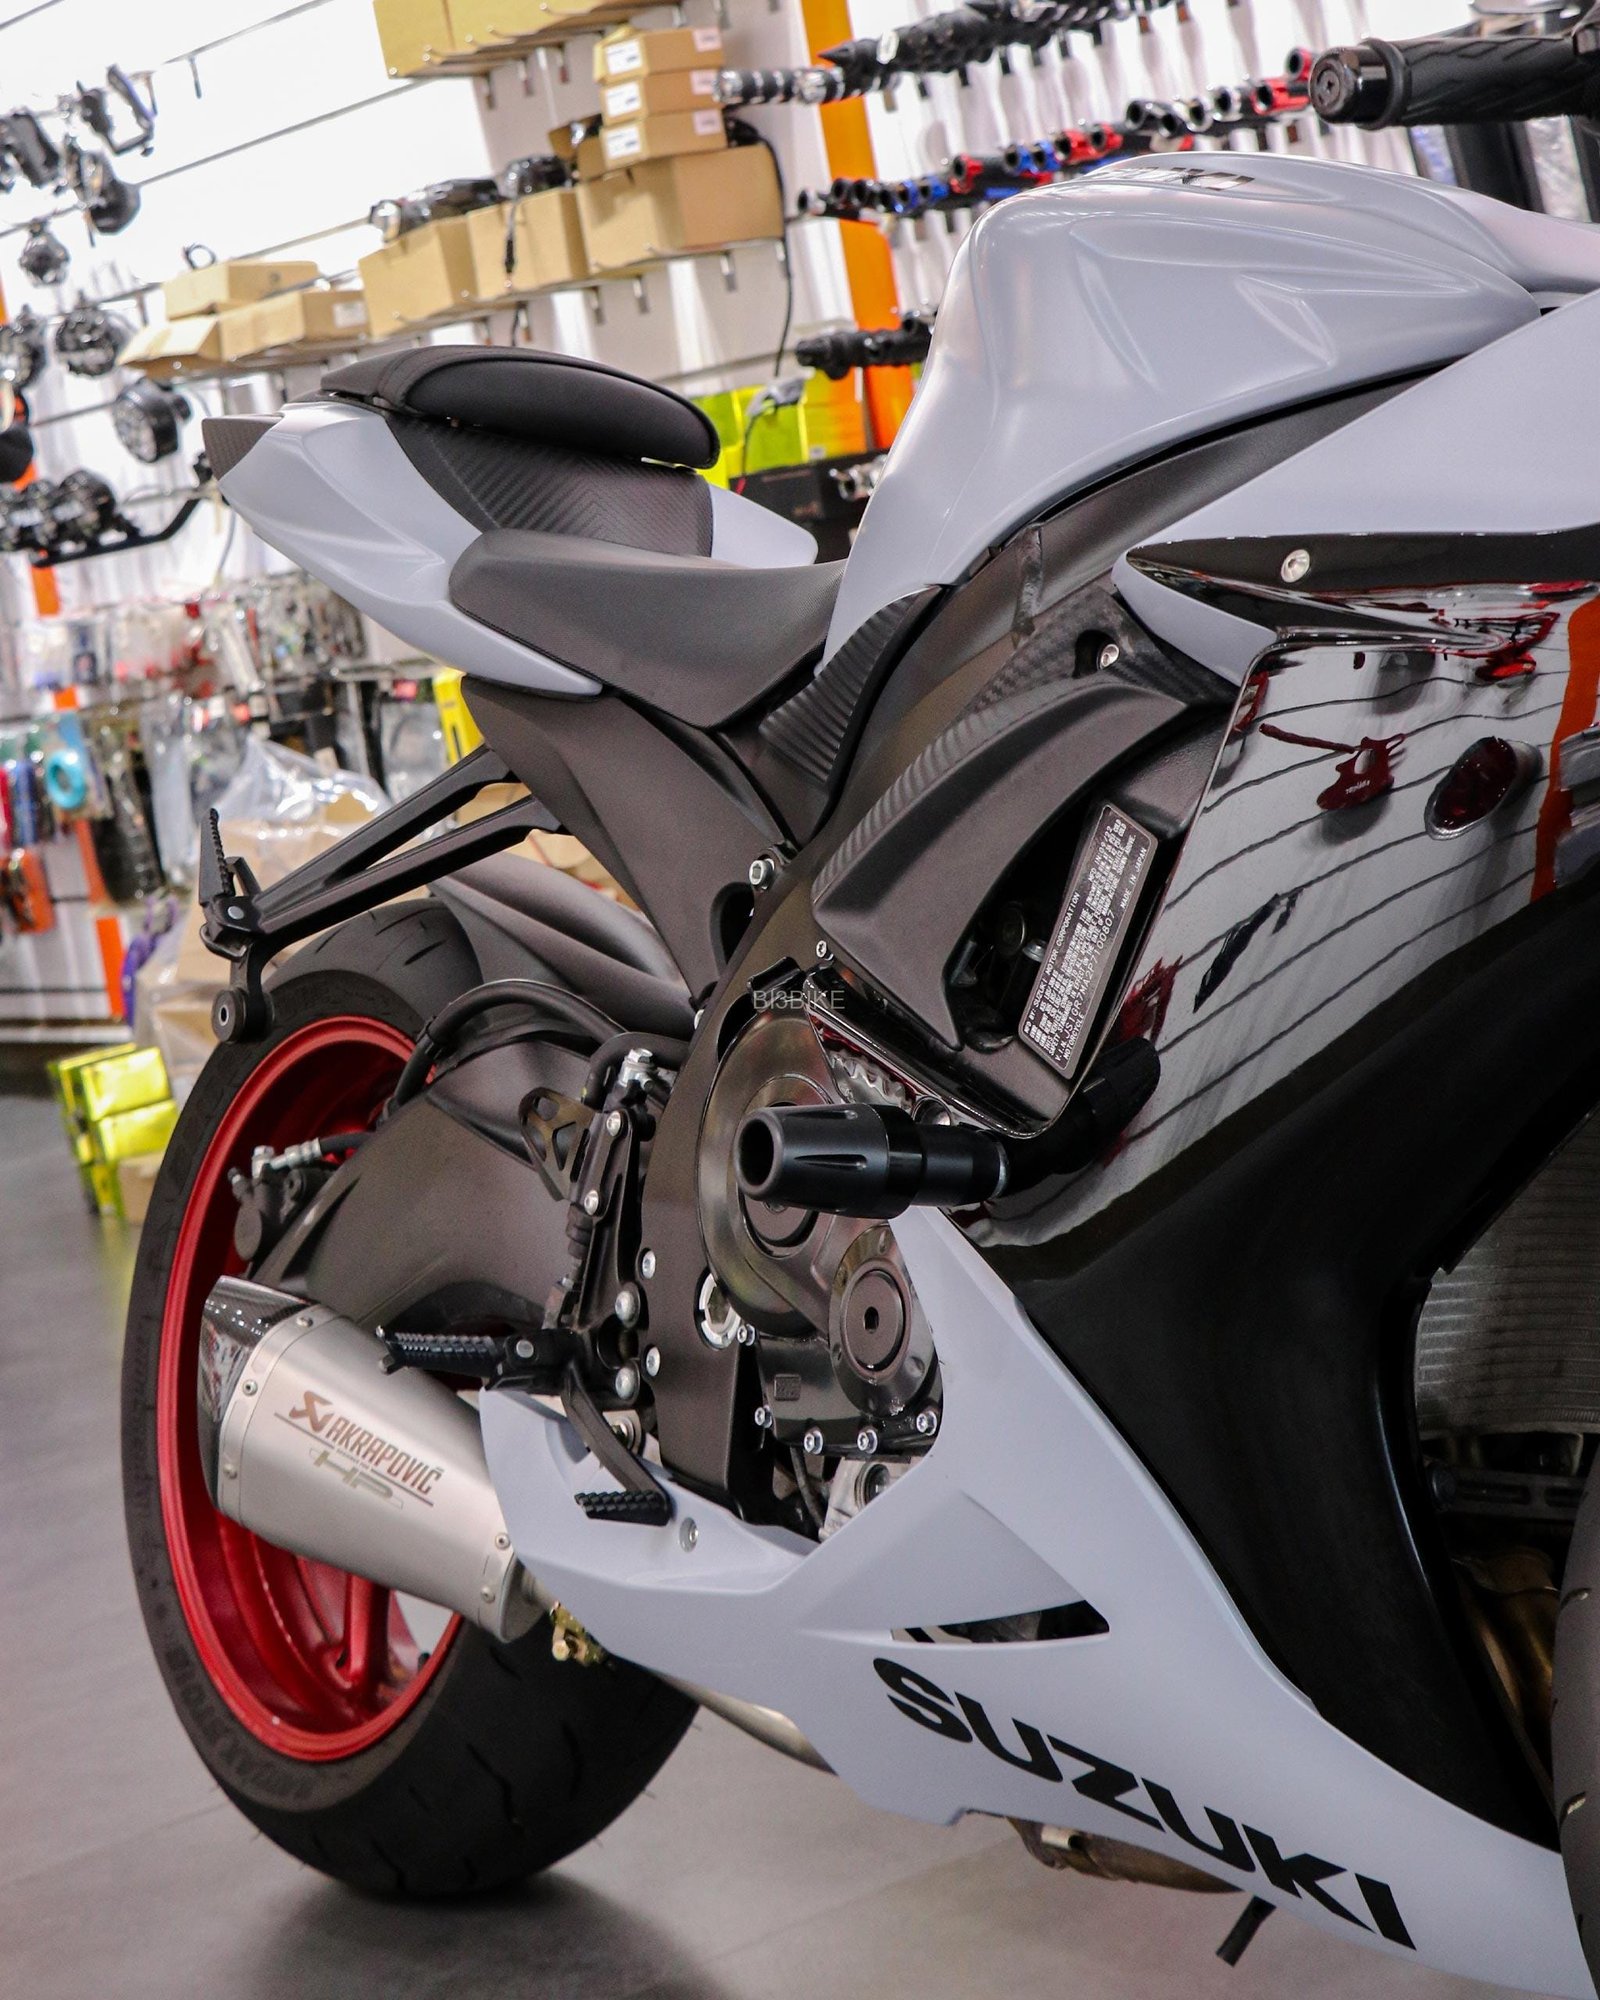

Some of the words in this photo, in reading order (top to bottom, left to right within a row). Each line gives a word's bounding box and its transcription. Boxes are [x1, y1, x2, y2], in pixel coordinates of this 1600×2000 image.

[1120, 888, 1131, 909] MADE
[1129, 874, 1136, 885] IN
[1134, 847, 1147, 873] JAPAN
[1033, 978, 1048, 1008] SUZUKI
[1045, 949, 1059, 976] MOTOR
[1056, 891, 1080, 948] CORPORATION
[1044, 1035, 1053, 1051] THIS
[1050, 1008, 1063, 1036] VEHICLE
[1112, 845, 1125, 871] VEHICLE
[1049, 1033, 1060, 1057] SAFETY
[1074, 967, 1085, 990] EFFECT
[1091, 926, 1101, 943] DATE
[1064, 1011, 1085, 1061] MOTORCYCLE
[873, 1657, 1417, 1951] SUZUKI
